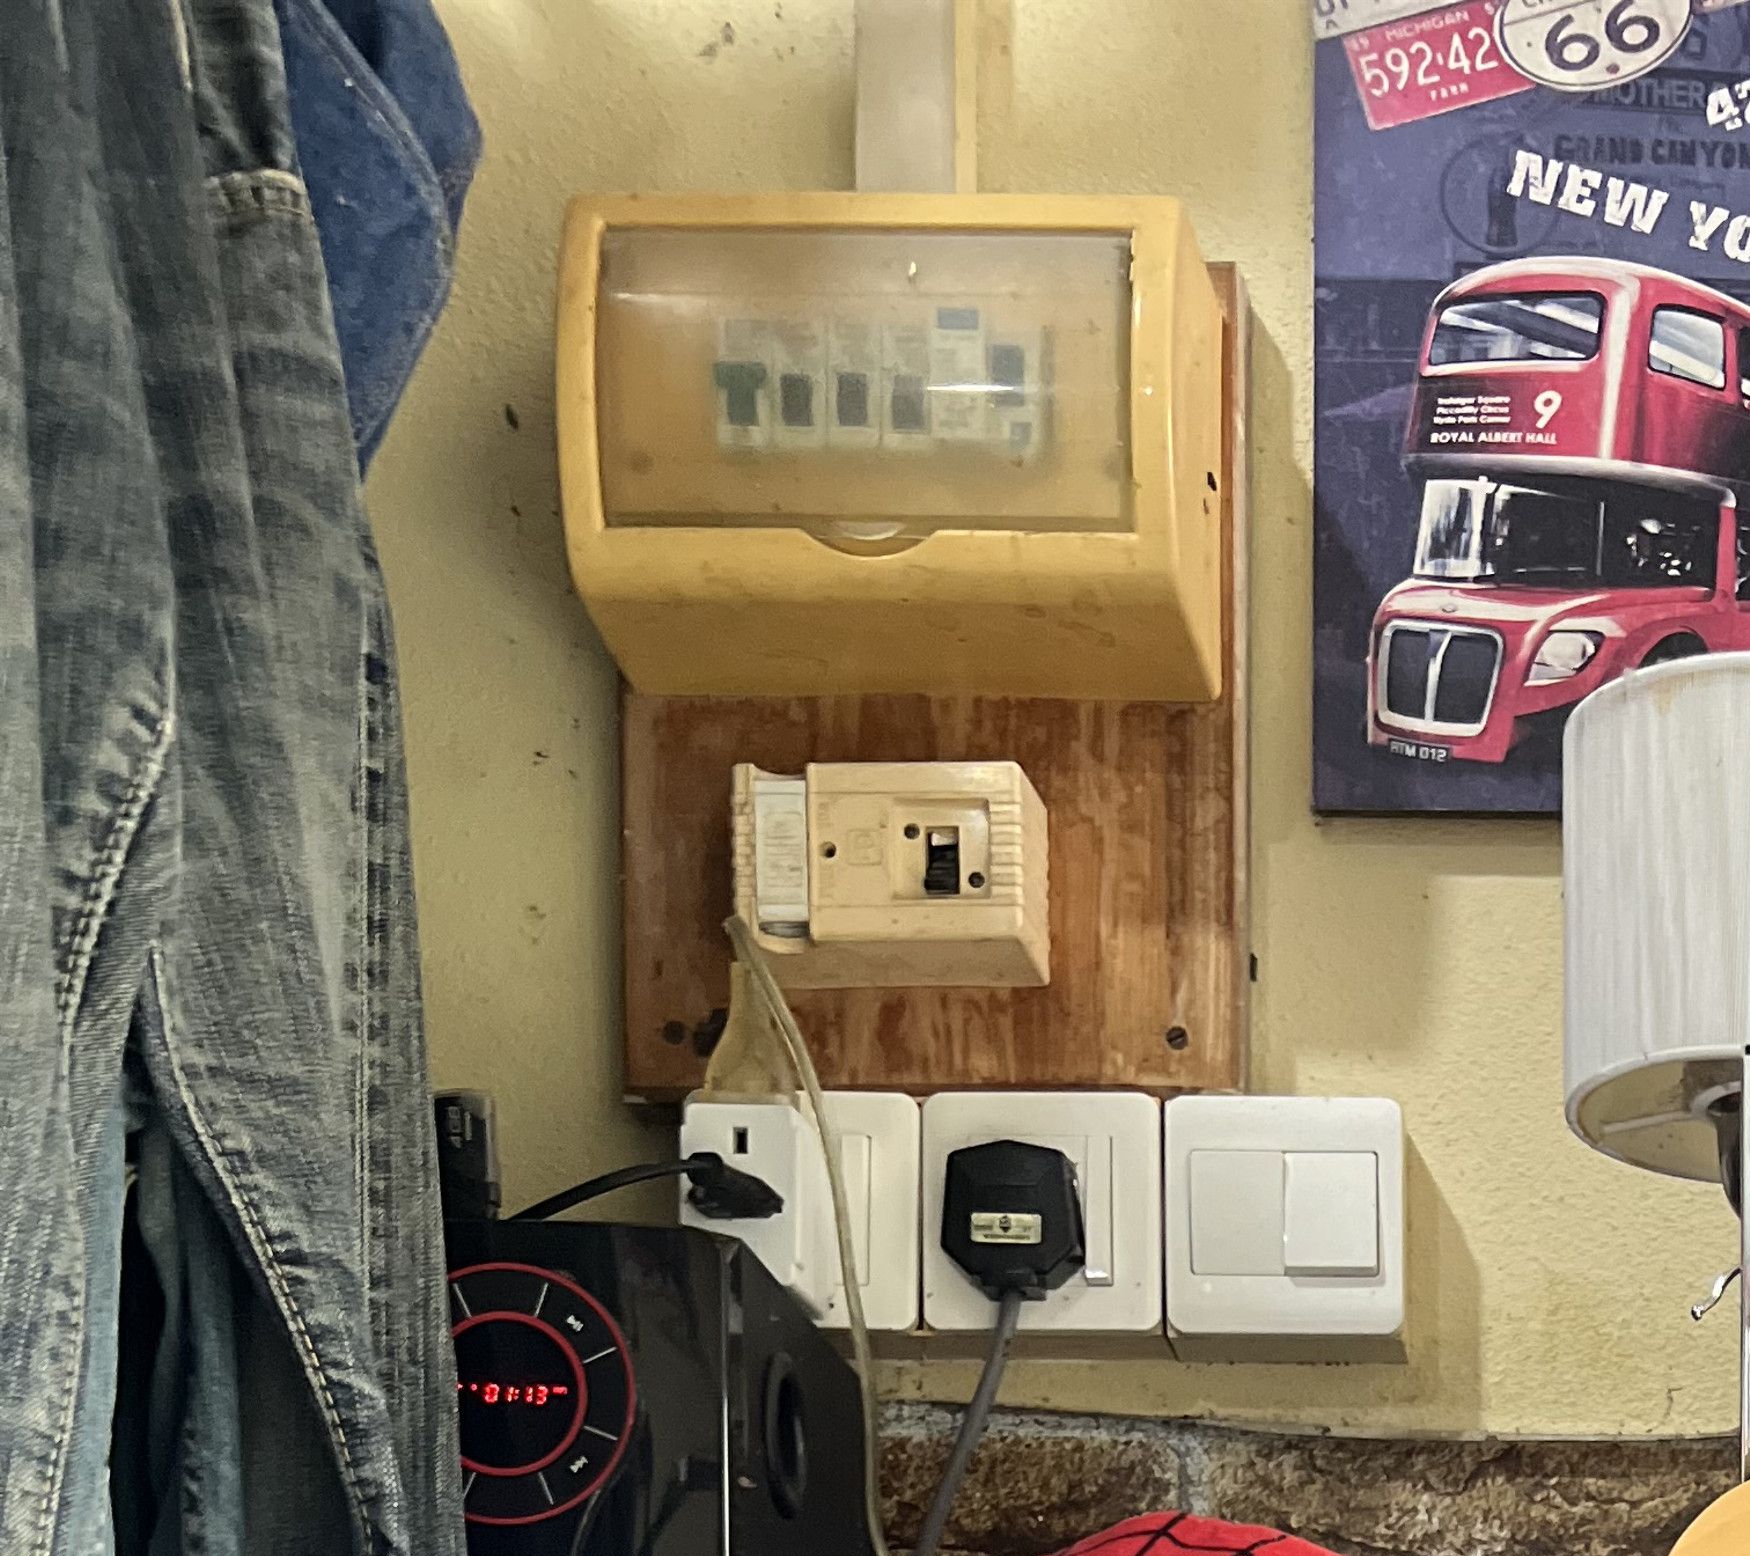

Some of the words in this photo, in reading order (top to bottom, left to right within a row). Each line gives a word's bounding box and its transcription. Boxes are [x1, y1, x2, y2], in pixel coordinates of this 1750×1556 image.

[1545, 0, 1660, 71] 66
[1506, 150, 1669, 235] NEW
[1534, 390, 1562, 429] 9
